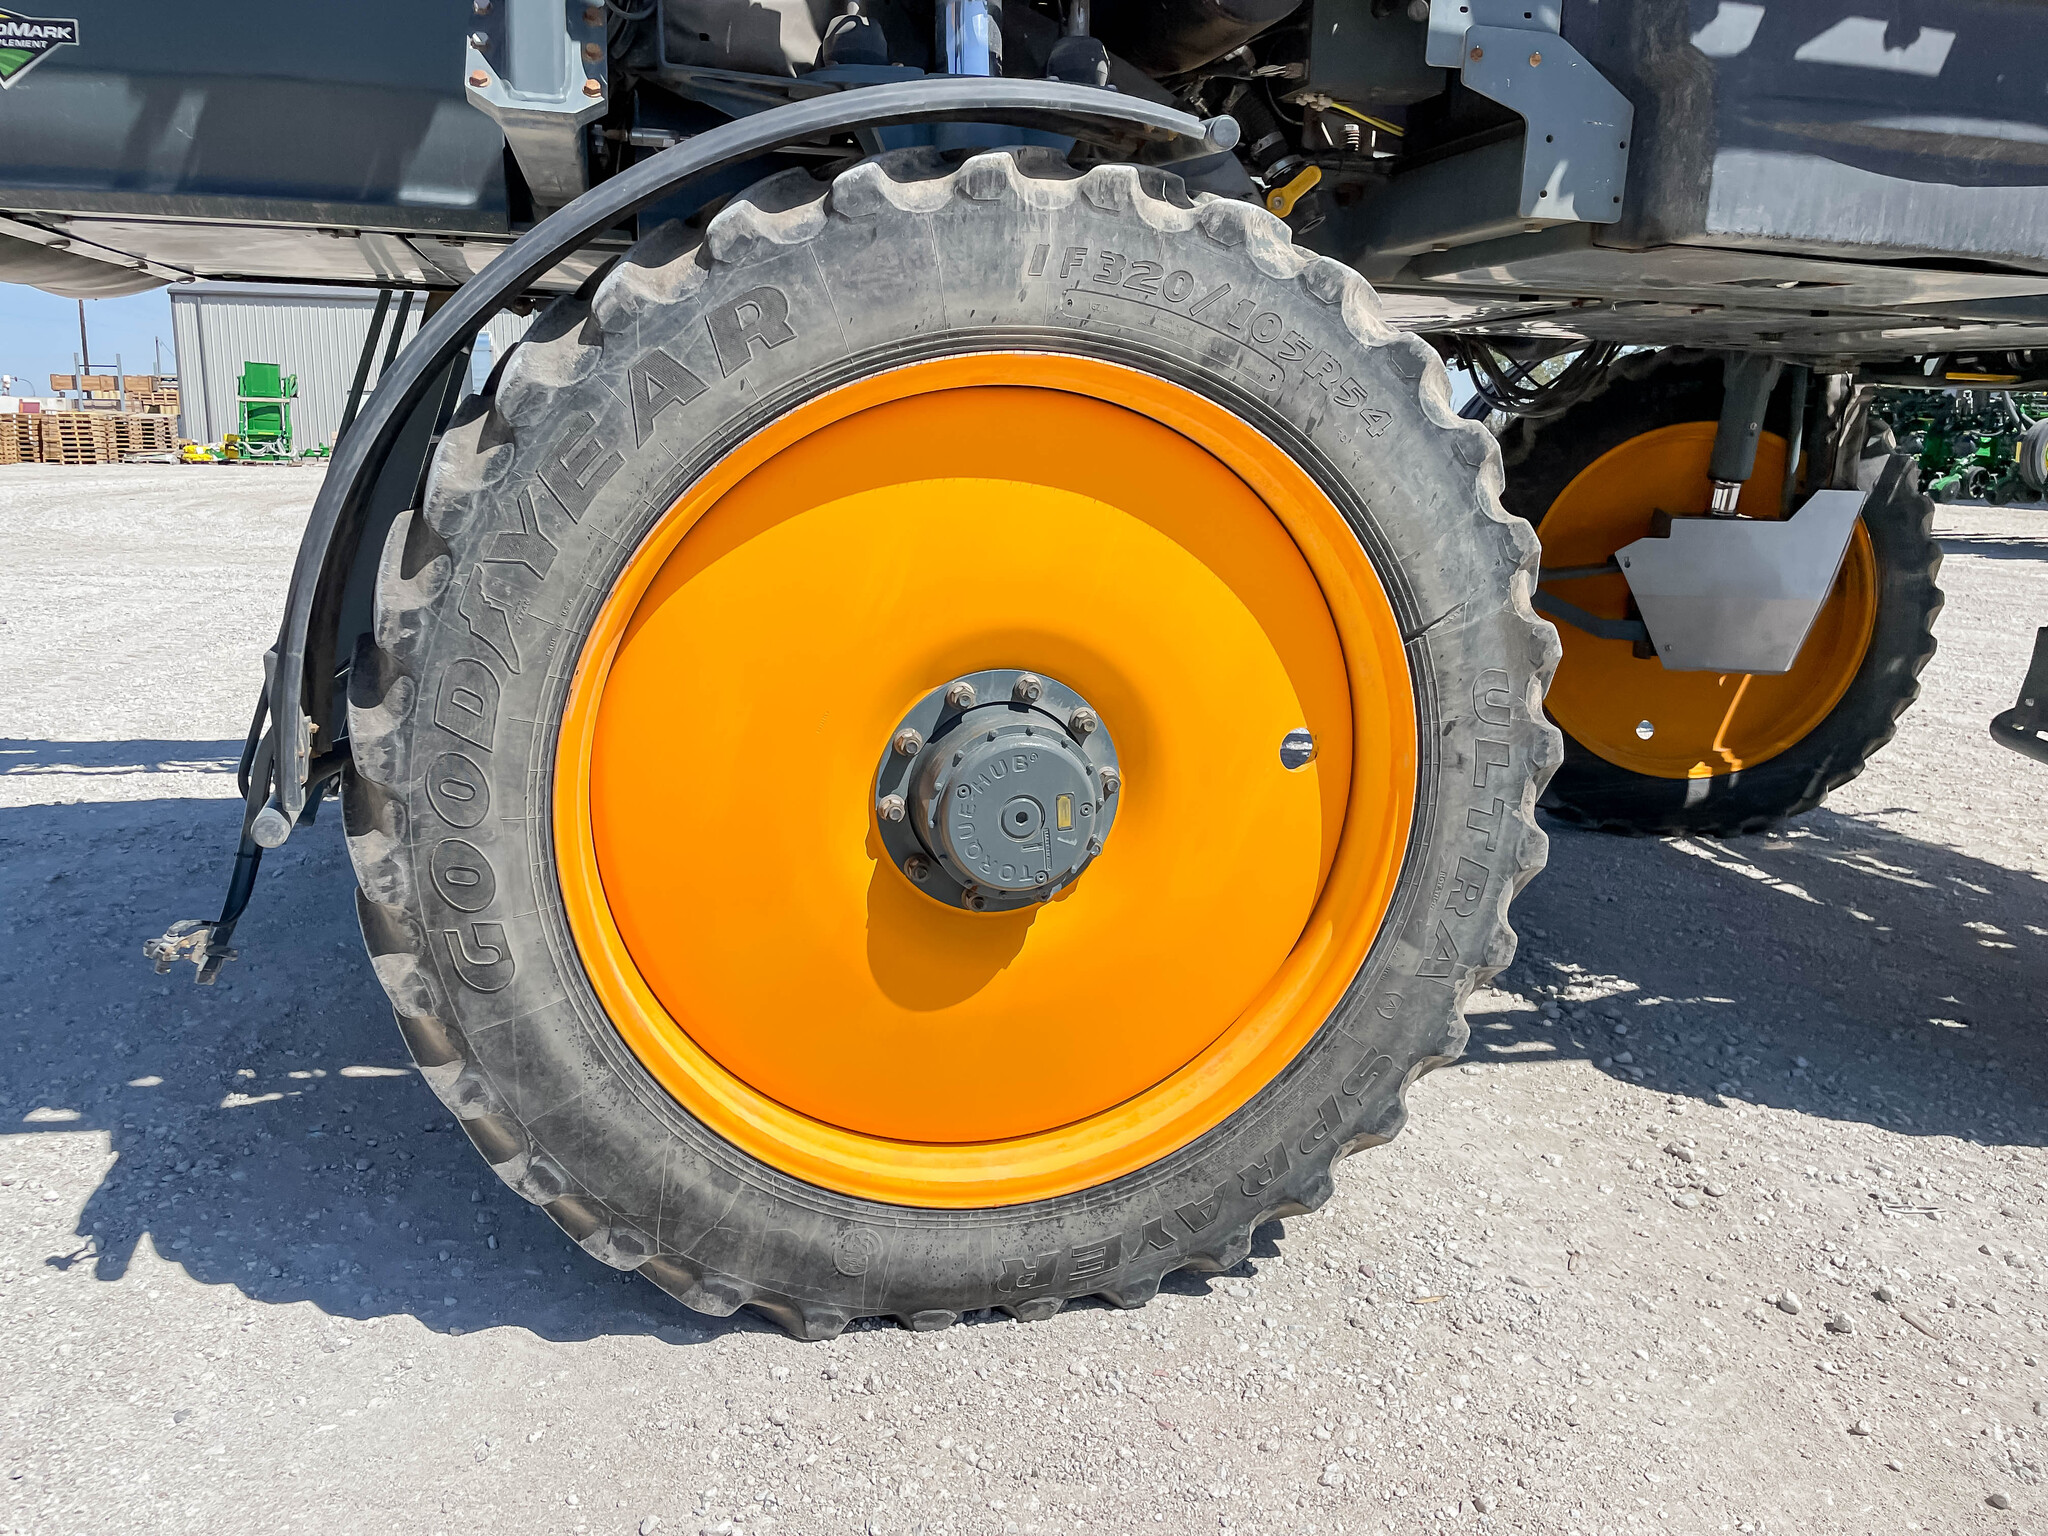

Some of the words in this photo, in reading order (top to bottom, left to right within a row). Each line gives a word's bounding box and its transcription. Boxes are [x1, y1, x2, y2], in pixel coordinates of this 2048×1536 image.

[427, 285, 798, 993] GOODYEAR
[1415, 668, 1511, 979] ULTRA
[997, 1046, 1393, 1293] SPRAYER
